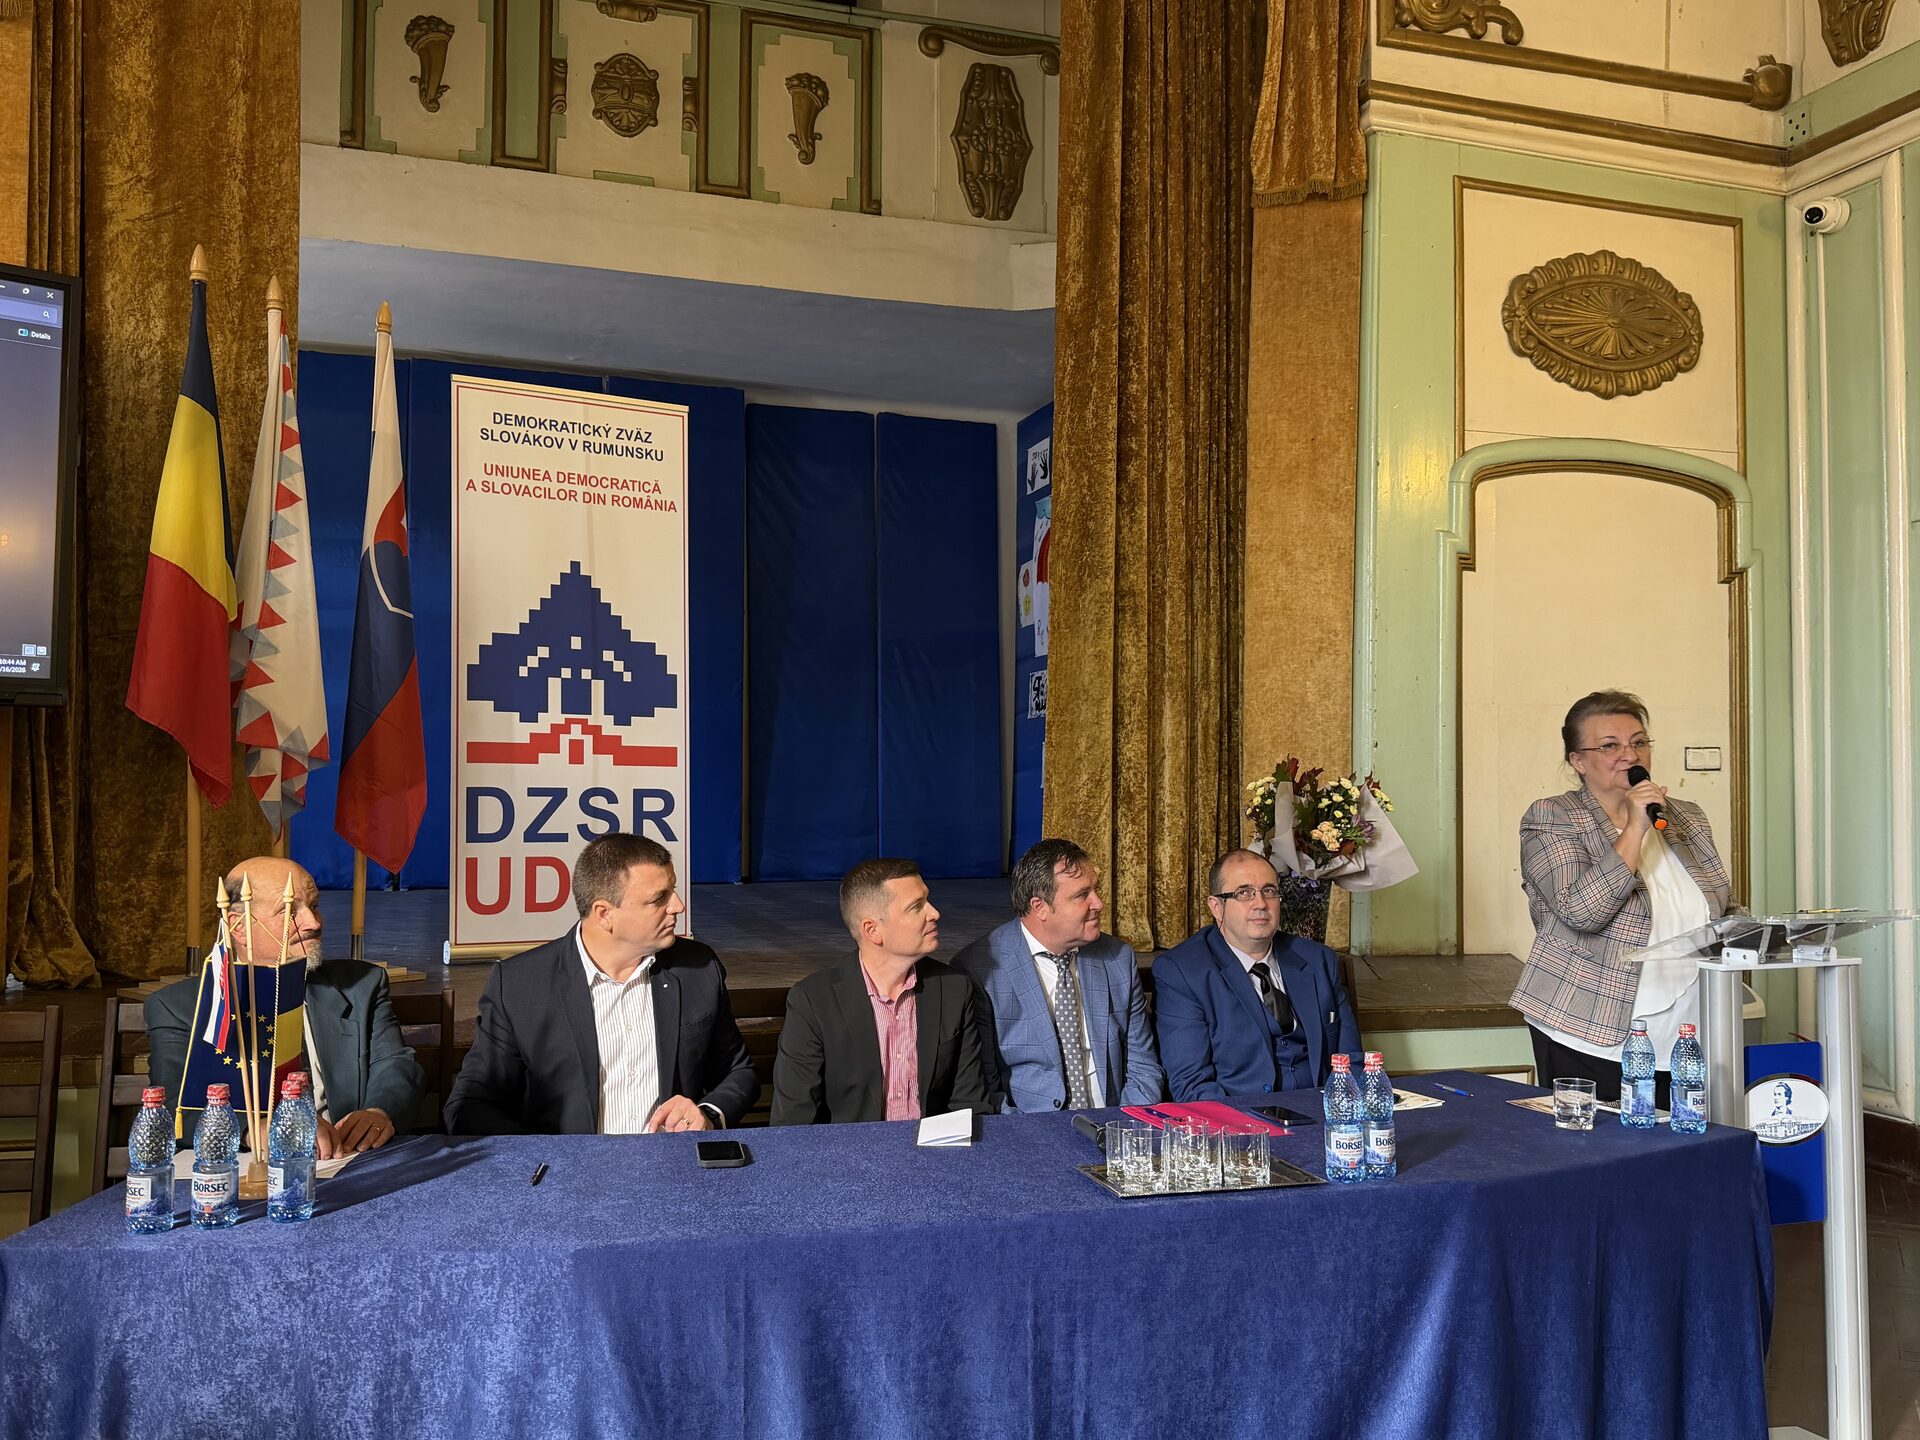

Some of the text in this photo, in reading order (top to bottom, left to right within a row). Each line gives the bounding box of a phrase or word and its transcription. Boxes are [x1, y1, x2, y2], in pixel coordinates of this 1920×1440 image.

[31, 331, 51, 340] Details
[493, 412, 653, 444] DEMOKRATICKÝ ZVÄZ
[480, 428, 664, 461] SLOVÁKOV V RUMUNSKU
[484, 463, 662, 494] UNIUNEA DEMOCRATICĂ
[466, 479, 677, 512] A SLOVACILOR DIN ROMÂNIA
[466, 786, 679, 843] DZSR
[193, 1180, 229, 1192] BORSEC
